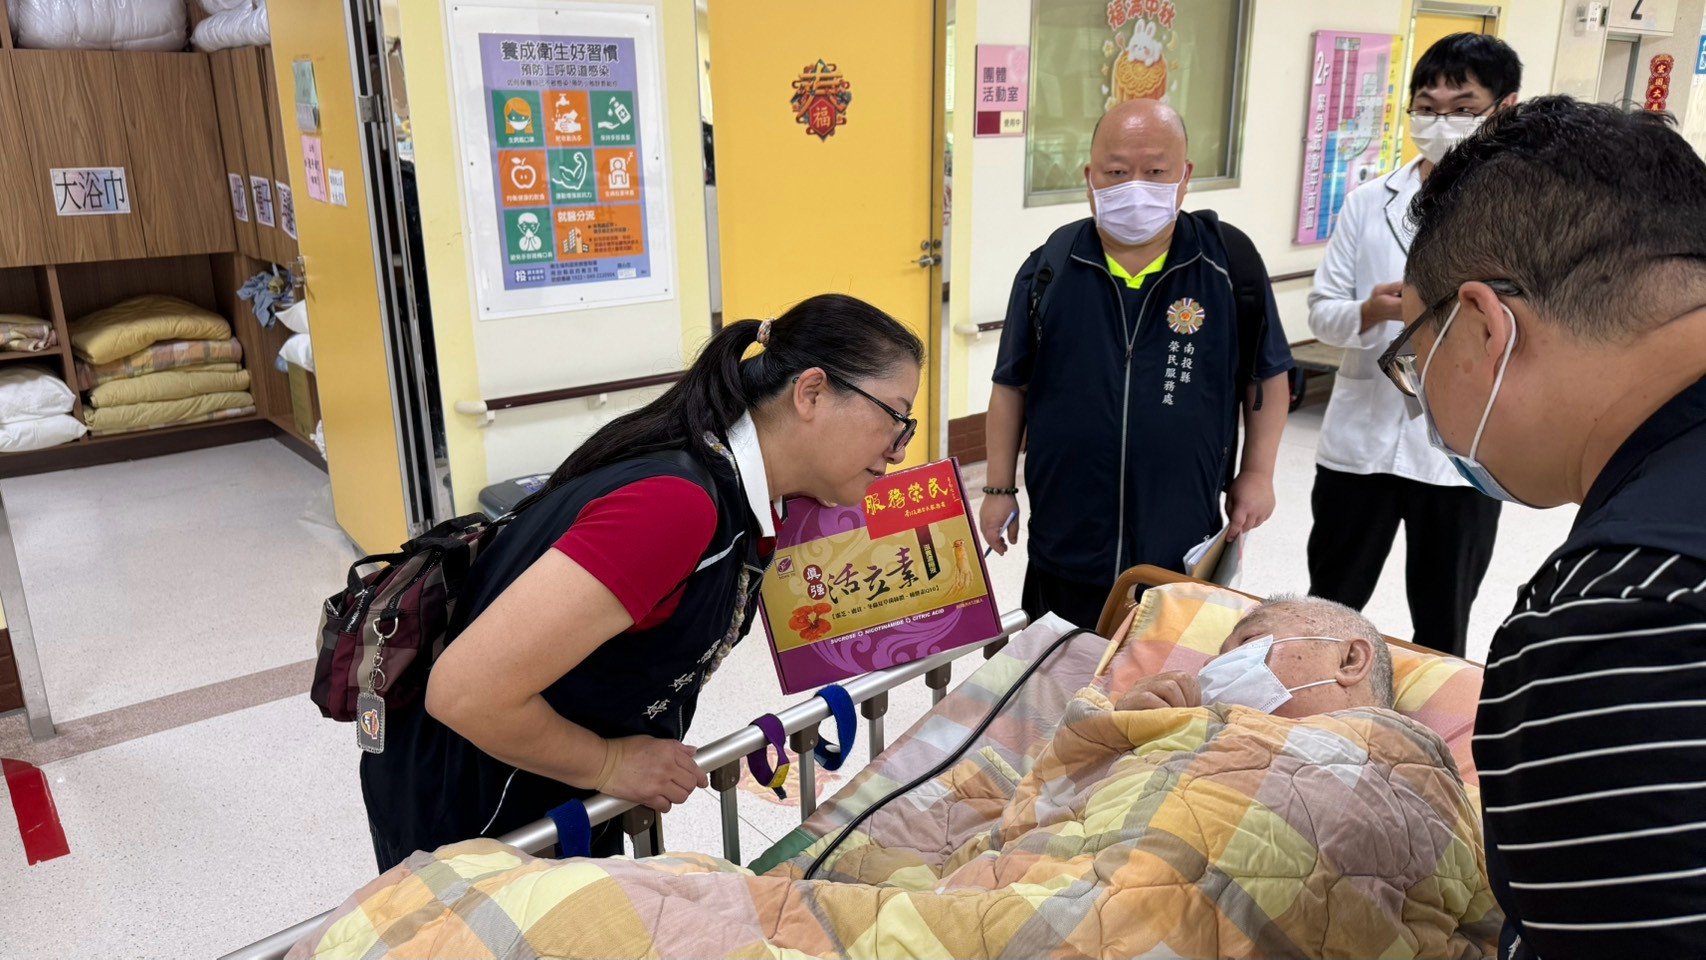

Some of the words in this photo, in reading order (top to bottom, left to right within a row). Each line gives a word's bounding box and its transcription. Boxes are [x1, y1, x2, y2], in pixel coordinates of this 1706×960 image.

[1107, 0, 1176, 30] 福滿中秋
[501, 41, 619, 62] 養成衛生好習慣
[521, 64, 609, 77] 預防上呼吸道感染
[983, 67, 1007, 83] 團體
[1314, 51, 1330, 86] 2F
[983, 86, 1019, 102] 活動室
[813, 106, 831, 129] 福
[1003, 118, 1021, 127] 使用中
[55, 170, 125, 211] 大浴巾
[558, 210, 596, 223] 就醫分流
[1162, 341, 1180, 405] 榮民服務處
[1180, 342, 1195, 383] 南投縣
[827, 547, 919, 605] 活立素
[830, 634, 857, 645] SUCROSE
[864, 620, 905, 635] NICOTINAMIDE
[912, 612, 931, 622] CITRIC
[931, 608, 945, 616] ACID
